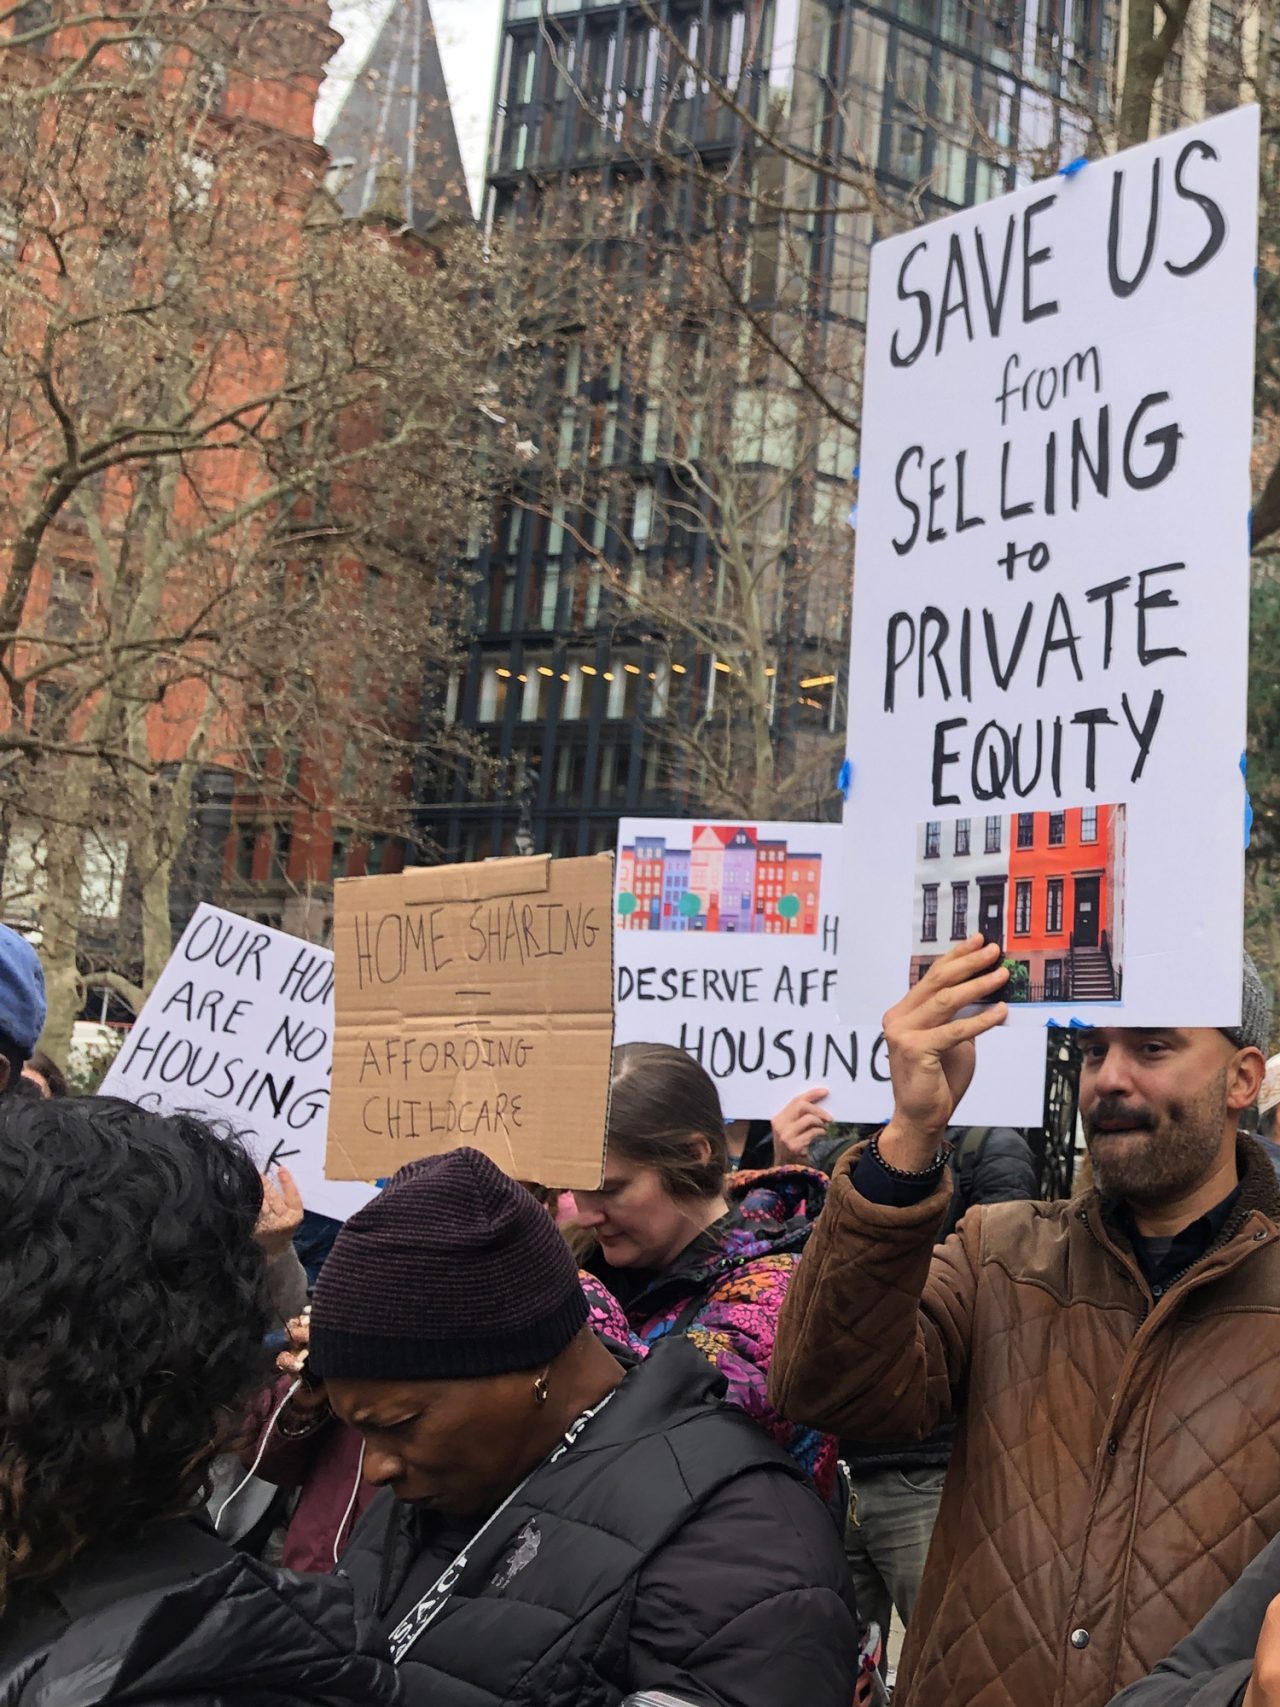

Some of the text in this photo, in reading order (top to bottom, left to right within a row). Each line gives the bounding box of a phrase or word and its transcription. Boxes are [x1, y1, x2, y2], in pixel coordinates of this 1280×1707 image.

[889, 138, 1227, 369] SAVE US
[995, 346, 1100, 425] from
[891, 391, 1184, 556] SELLING
[997, 541, 1050, 580] to
[883, 562, 1188, 713] PRIVATE
[931, 688, 1165, 807] EQUITY
[184, 915, 335, 1006] OUR HO
[354, 900, 600, 989] HOME SHARING
[617, 966, 763, 1003] DESERVE
[161, 980, 333, 1077] ARE NO
[359, 1038, 534, 1083] AFFORDING
[121, 1026, 331, 1130] HOUSING
[362, 1092, 523, 1138] CHILDCARE
